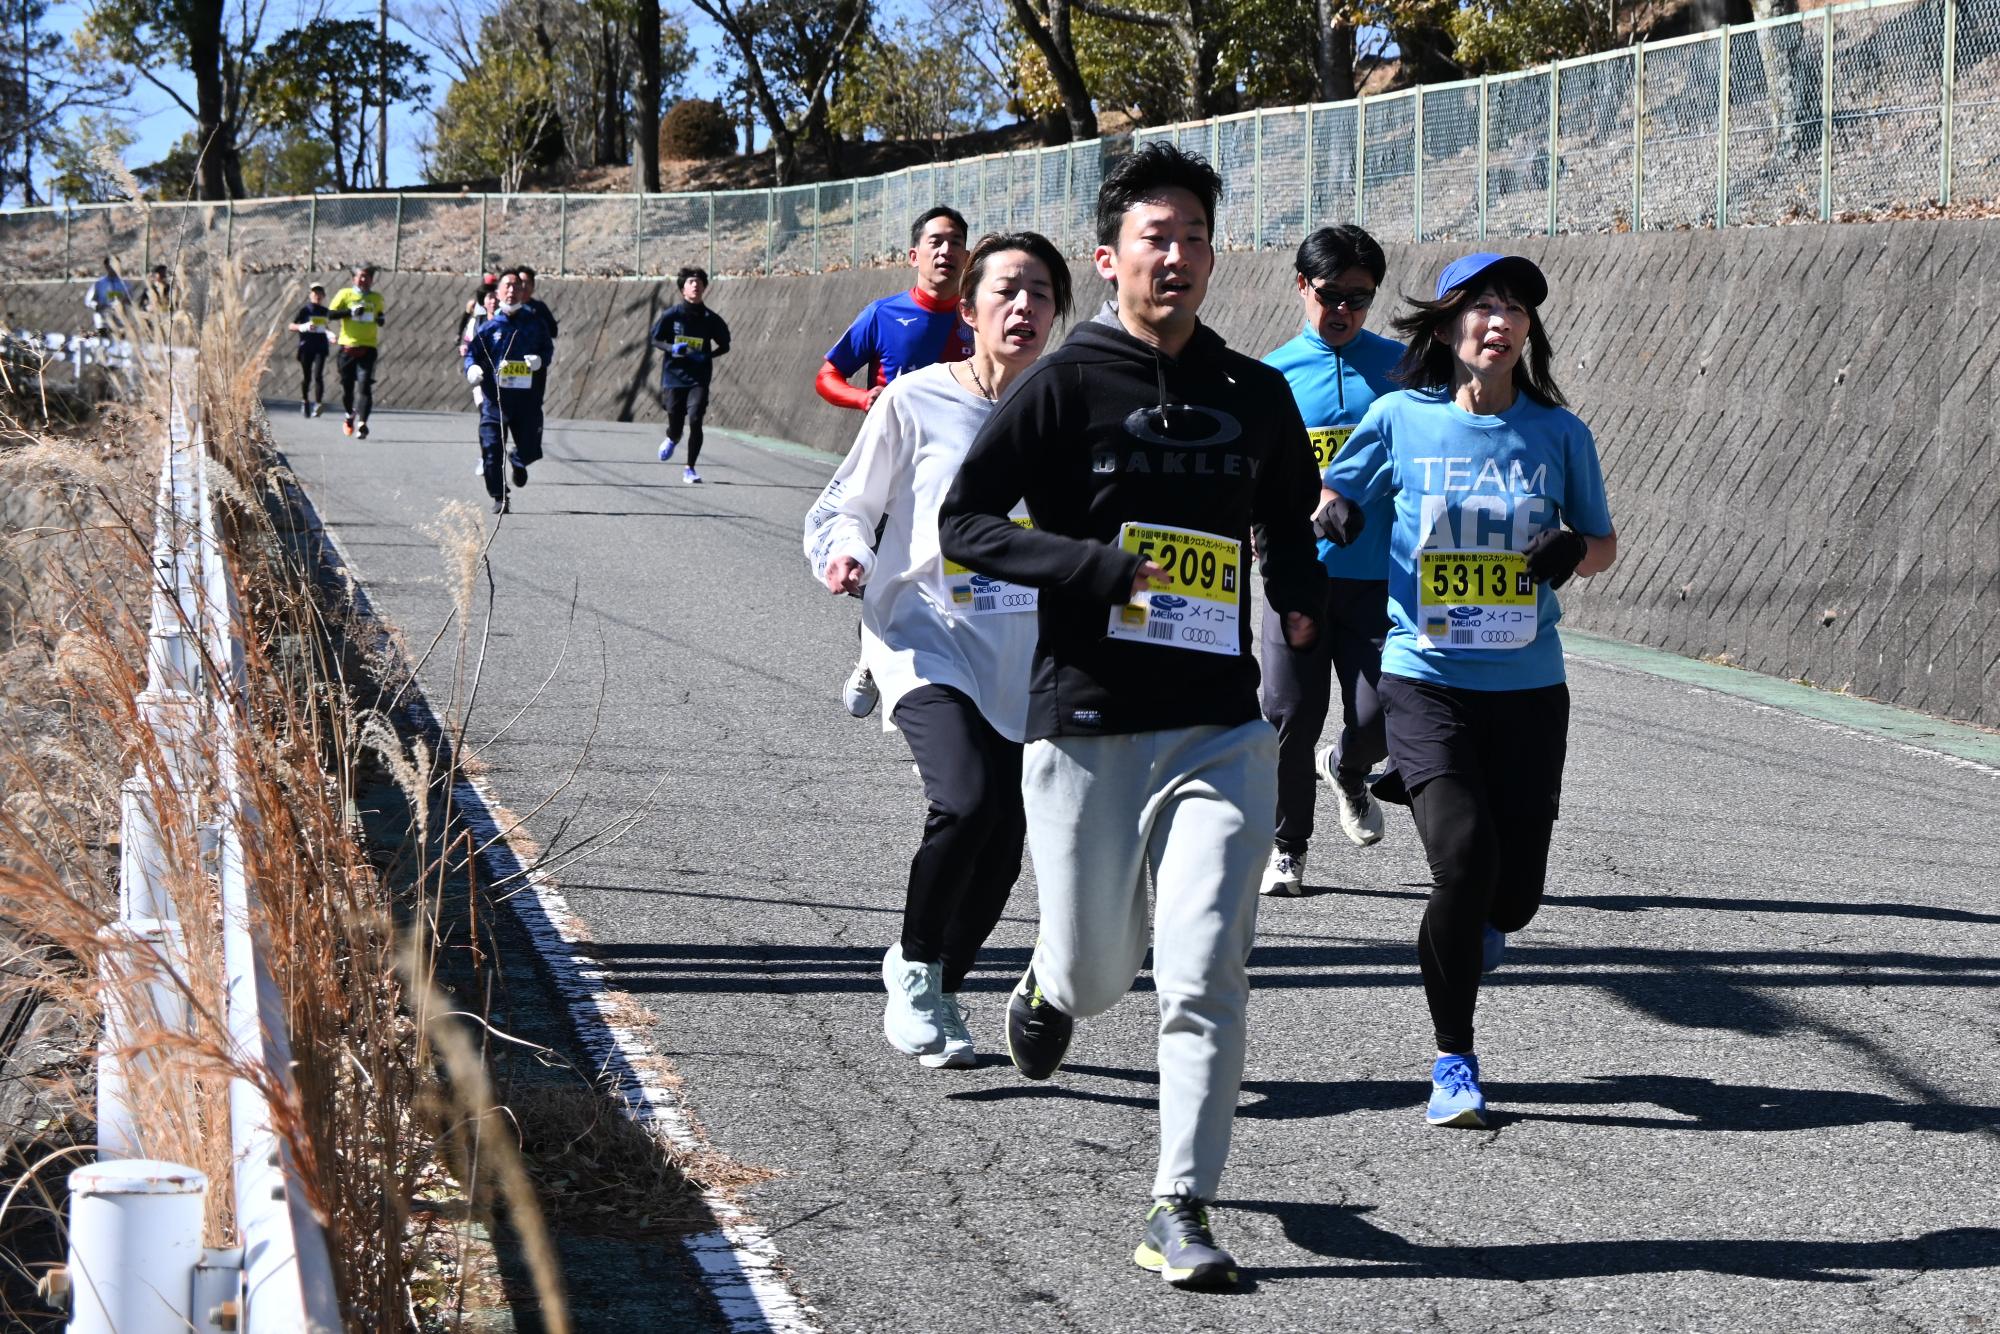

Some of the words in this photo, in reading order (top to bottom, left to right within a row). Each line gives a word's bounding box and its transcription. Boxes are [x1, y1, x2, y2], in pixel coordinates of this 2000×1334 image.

[1312, 436, 1350, 463] 52
[1092, 451, 1261, 479] OAKLEY
[1413, 457, 1547, 495] TEAM
[1418, 494, 1546, 550] ACE
[974, 585, 1001, 594] MEIKO
[1433, 564, 1507, 597] 5313
[1150, 609, 1184, 622] MEIKO
[1189, 606, 1236, 622] メイコー
[1451, 619, 1481, 627] MEIKO
[1485, 610, 1535, 623] メイコー
